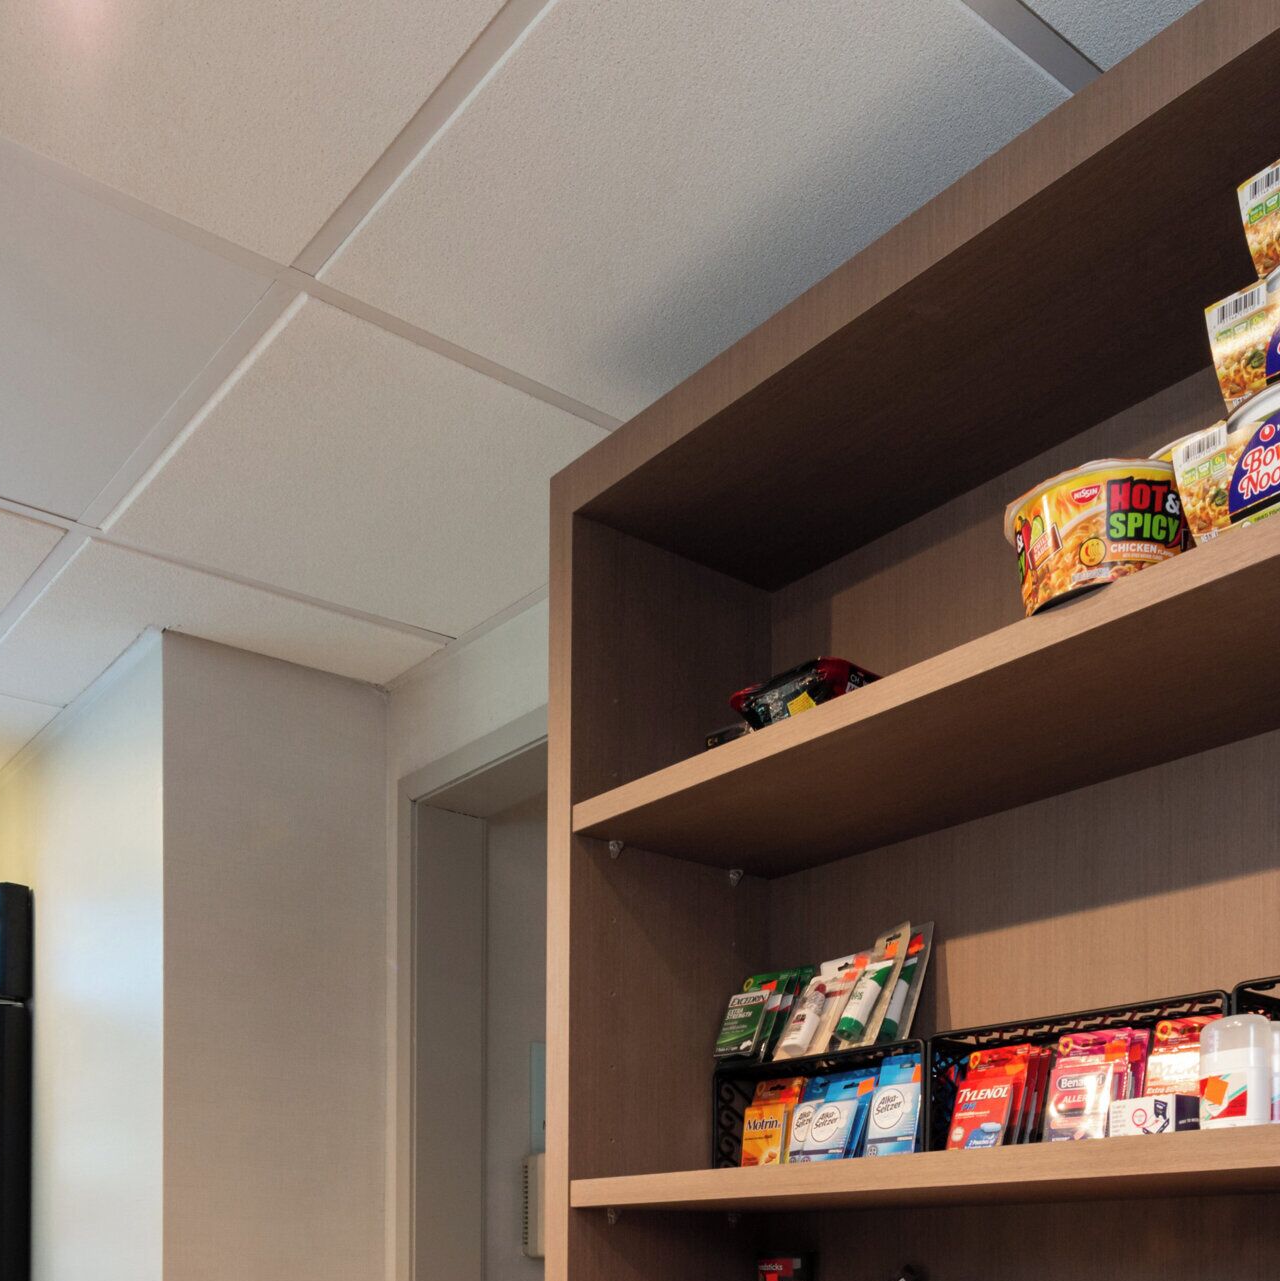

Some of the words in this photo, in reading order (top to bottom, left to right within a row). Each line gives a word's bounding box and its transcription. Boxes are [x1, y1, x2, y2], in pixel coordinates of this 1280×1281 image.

[1110, 483, 1168, 512] HOT
[1109, 512, 1179, 542] SPICY
[1111, 543, 1157, 553] CHICKEN
[959, 1086, 1009, 1103] TYLENOL
[875, 1101, 901, 1116] Seltzer
[746, 1118, 778, 1131] Motrin
[814, 1117, 838, 1129] Seltzer
